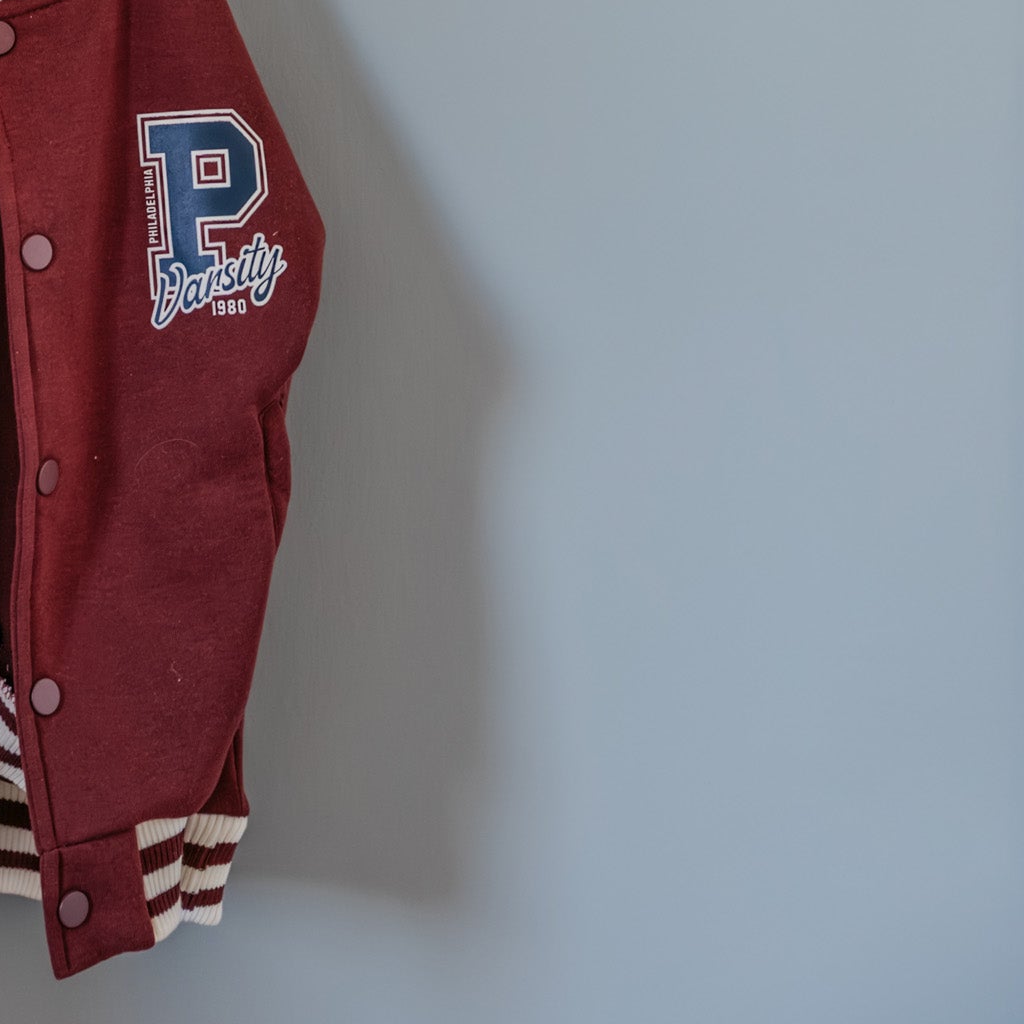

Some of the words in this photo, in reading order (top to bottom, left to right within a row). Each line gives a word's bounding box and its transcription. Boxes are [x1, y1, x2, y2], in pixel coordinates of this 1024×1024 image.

[137, 108, 269, 300] P
[143, 168, 159, 244] PHILADELPHIA
[152, 233, 286, 329] Varsity
[211, 298, 247, 316] 1980
